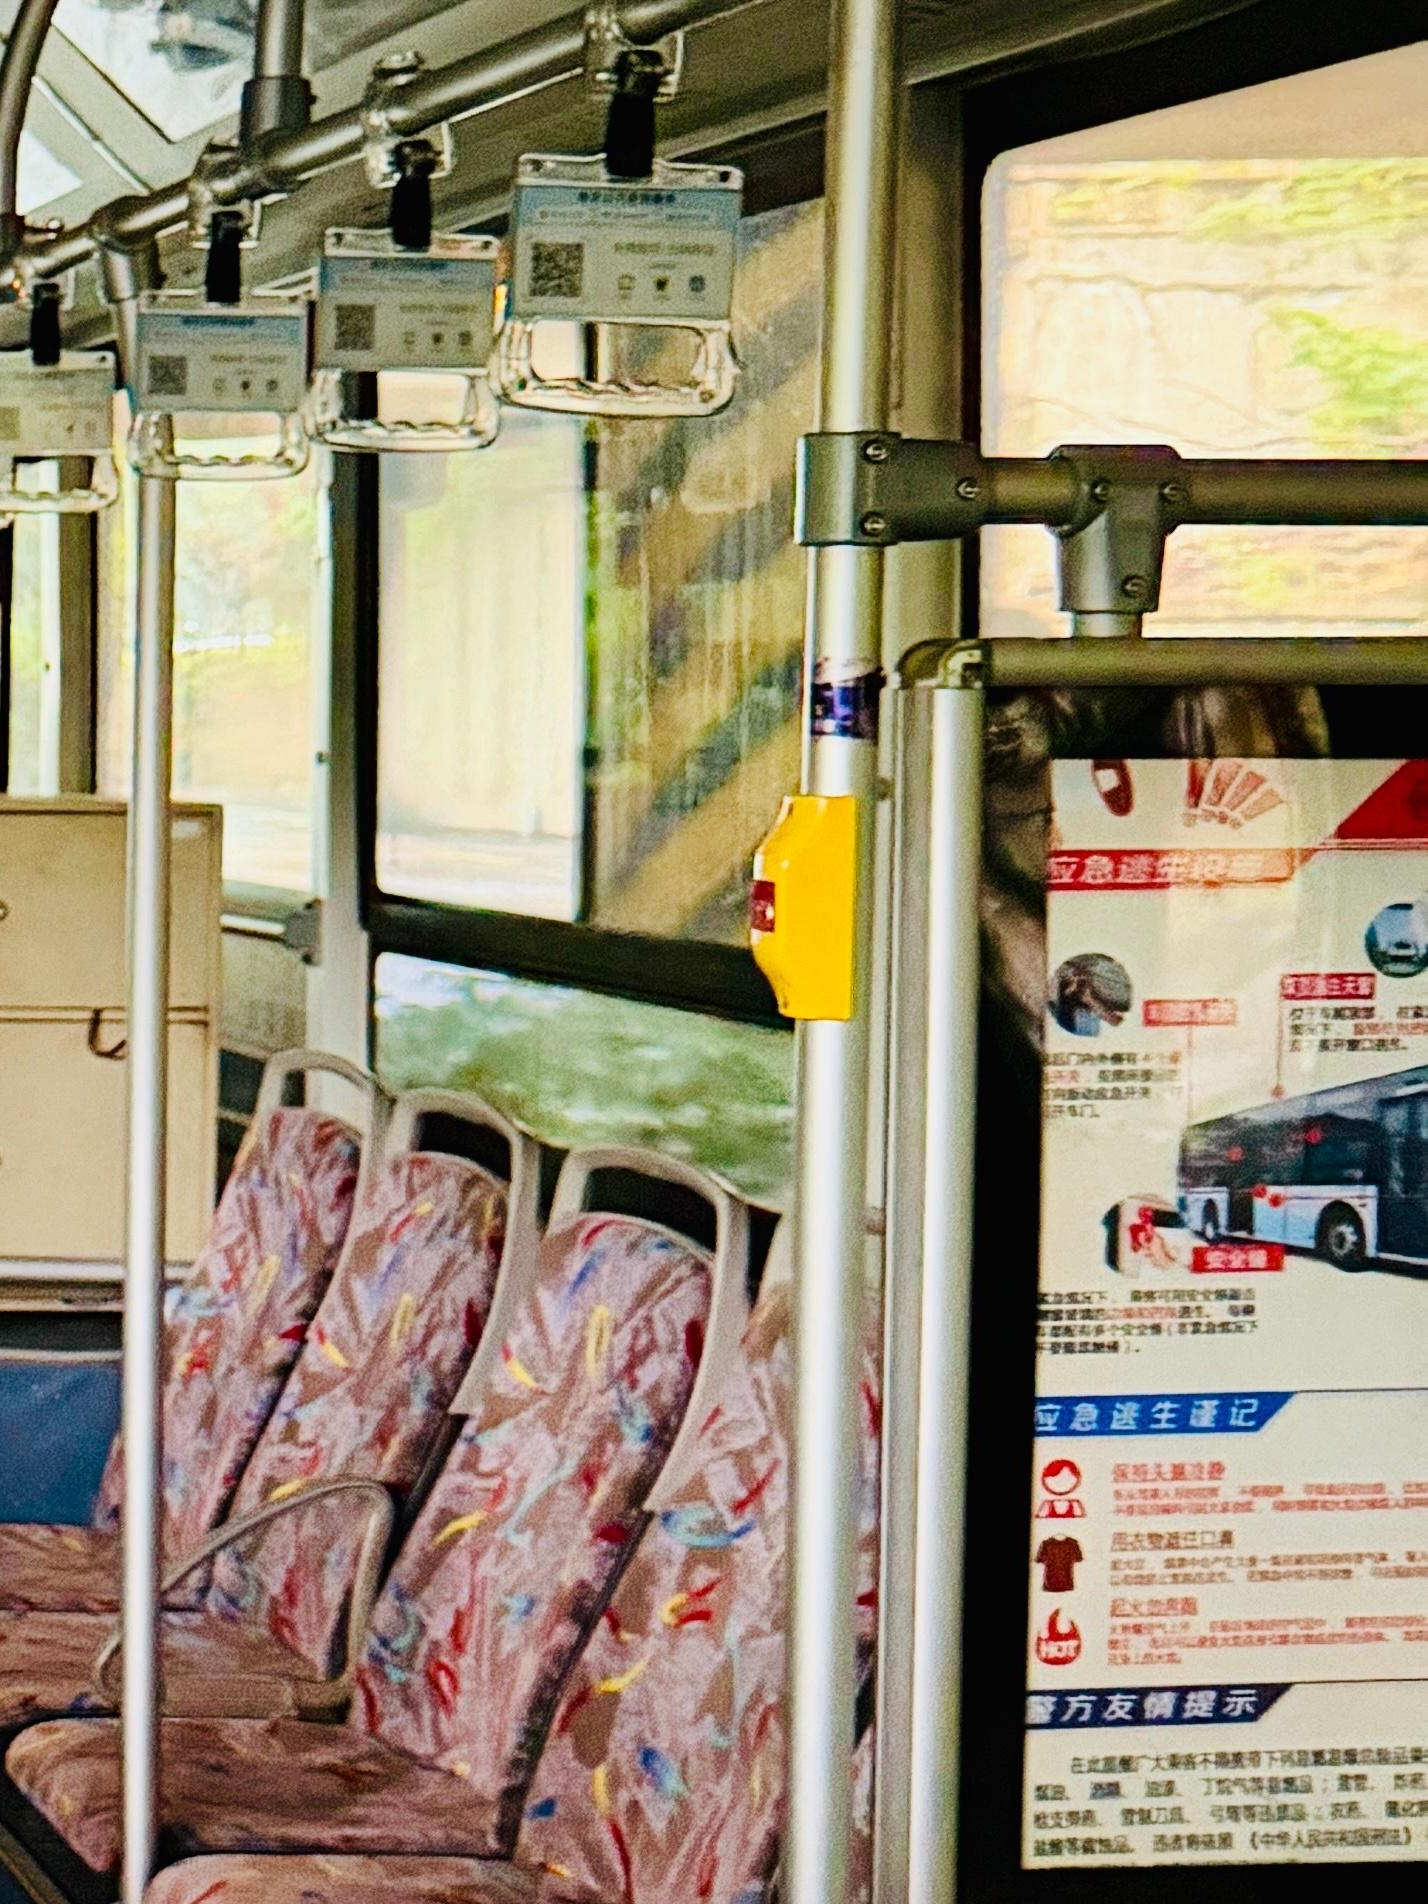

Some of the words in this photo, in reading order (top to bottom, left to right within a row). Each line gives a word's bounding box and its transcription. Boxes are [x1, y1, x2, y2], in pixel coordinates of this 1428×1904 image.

[1035, 1399, 1259, 1432] 应急逃生谨记
[1041, 1640, 1078, 1658] HOT
[1026, 1688, 1258, 1726] 警方友情提示
